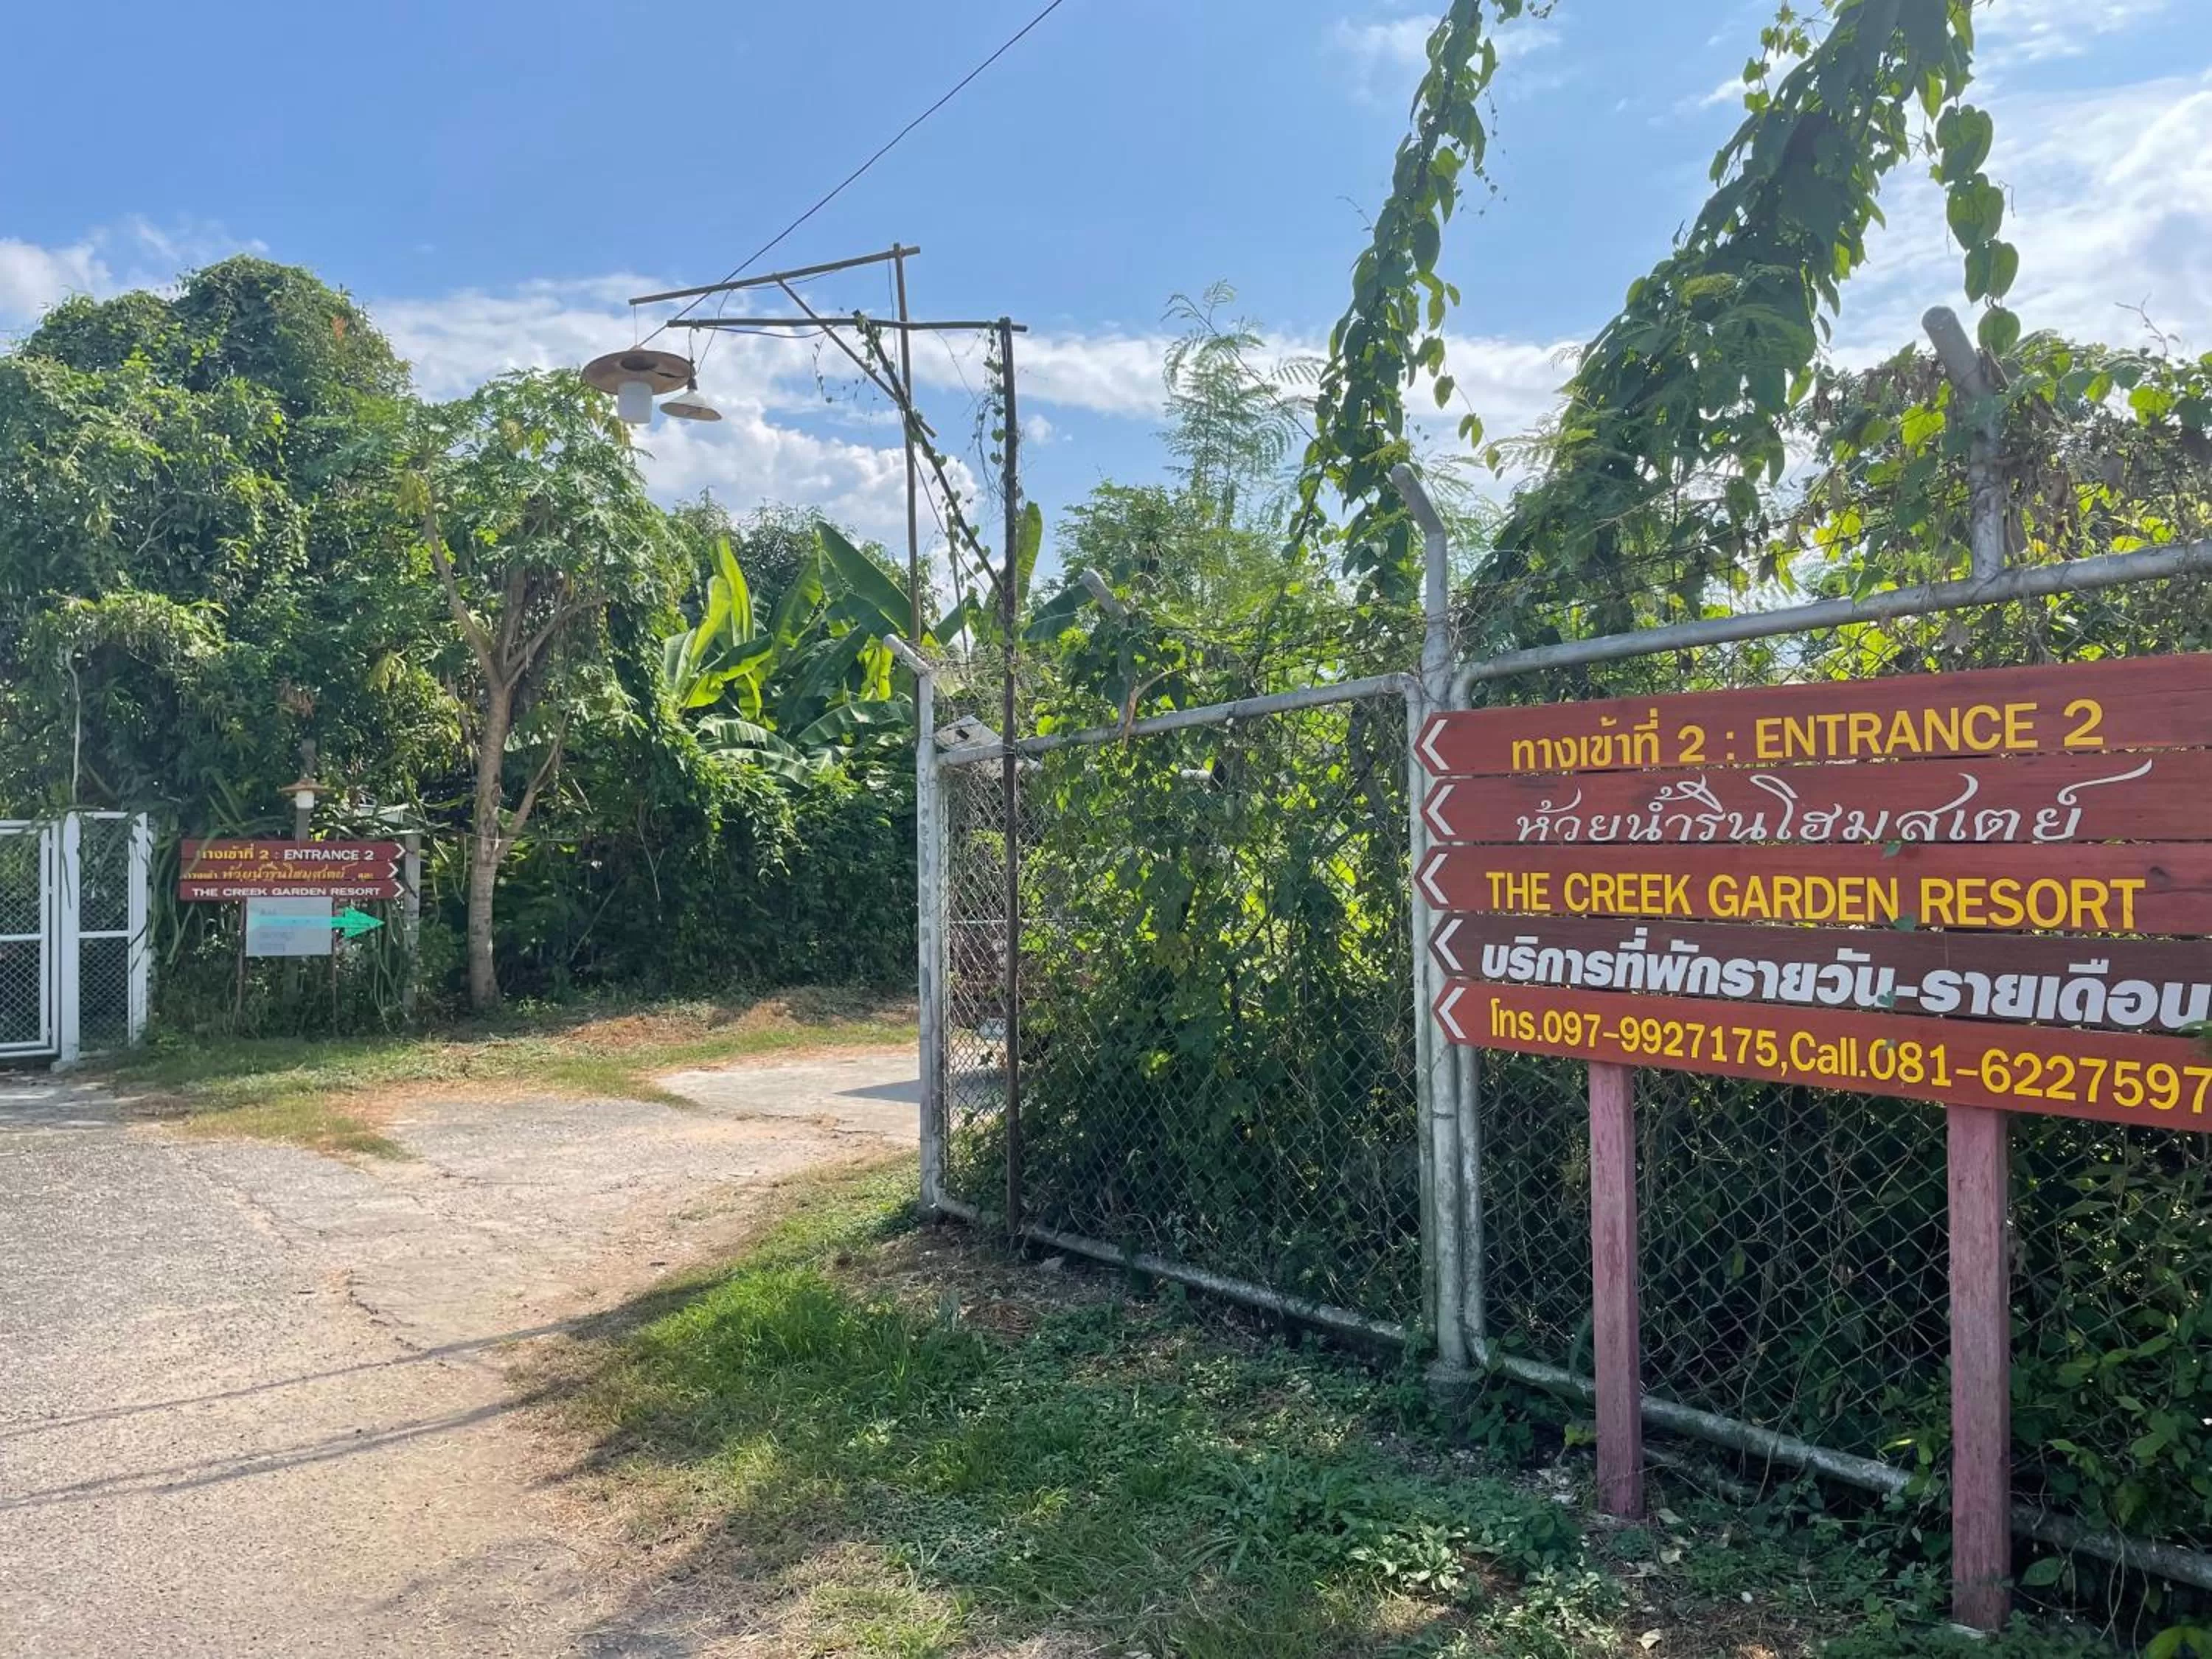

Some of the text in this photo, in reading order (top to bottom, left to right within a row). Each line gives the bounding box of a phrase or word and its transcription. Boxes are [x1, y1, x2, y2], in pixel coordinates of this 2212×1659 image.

[1512, 707, 1660, 771] ทางเข้าที่
[1677, 725, 1706, 763] 2
[1755, 703, 2039, 760] ENTRANCE
[2063, 698, 2104, 746] 2
[259, 849, 270, 860] 2
[284, 849, 360, 861] ENTRANCE
[364, 850, 375, 861] 2
[192, 887, 381, 897] THE CREEK GARDEN RESORT
[1486, 872, 2146, 930] THE CREEK GARDEN RESORT
